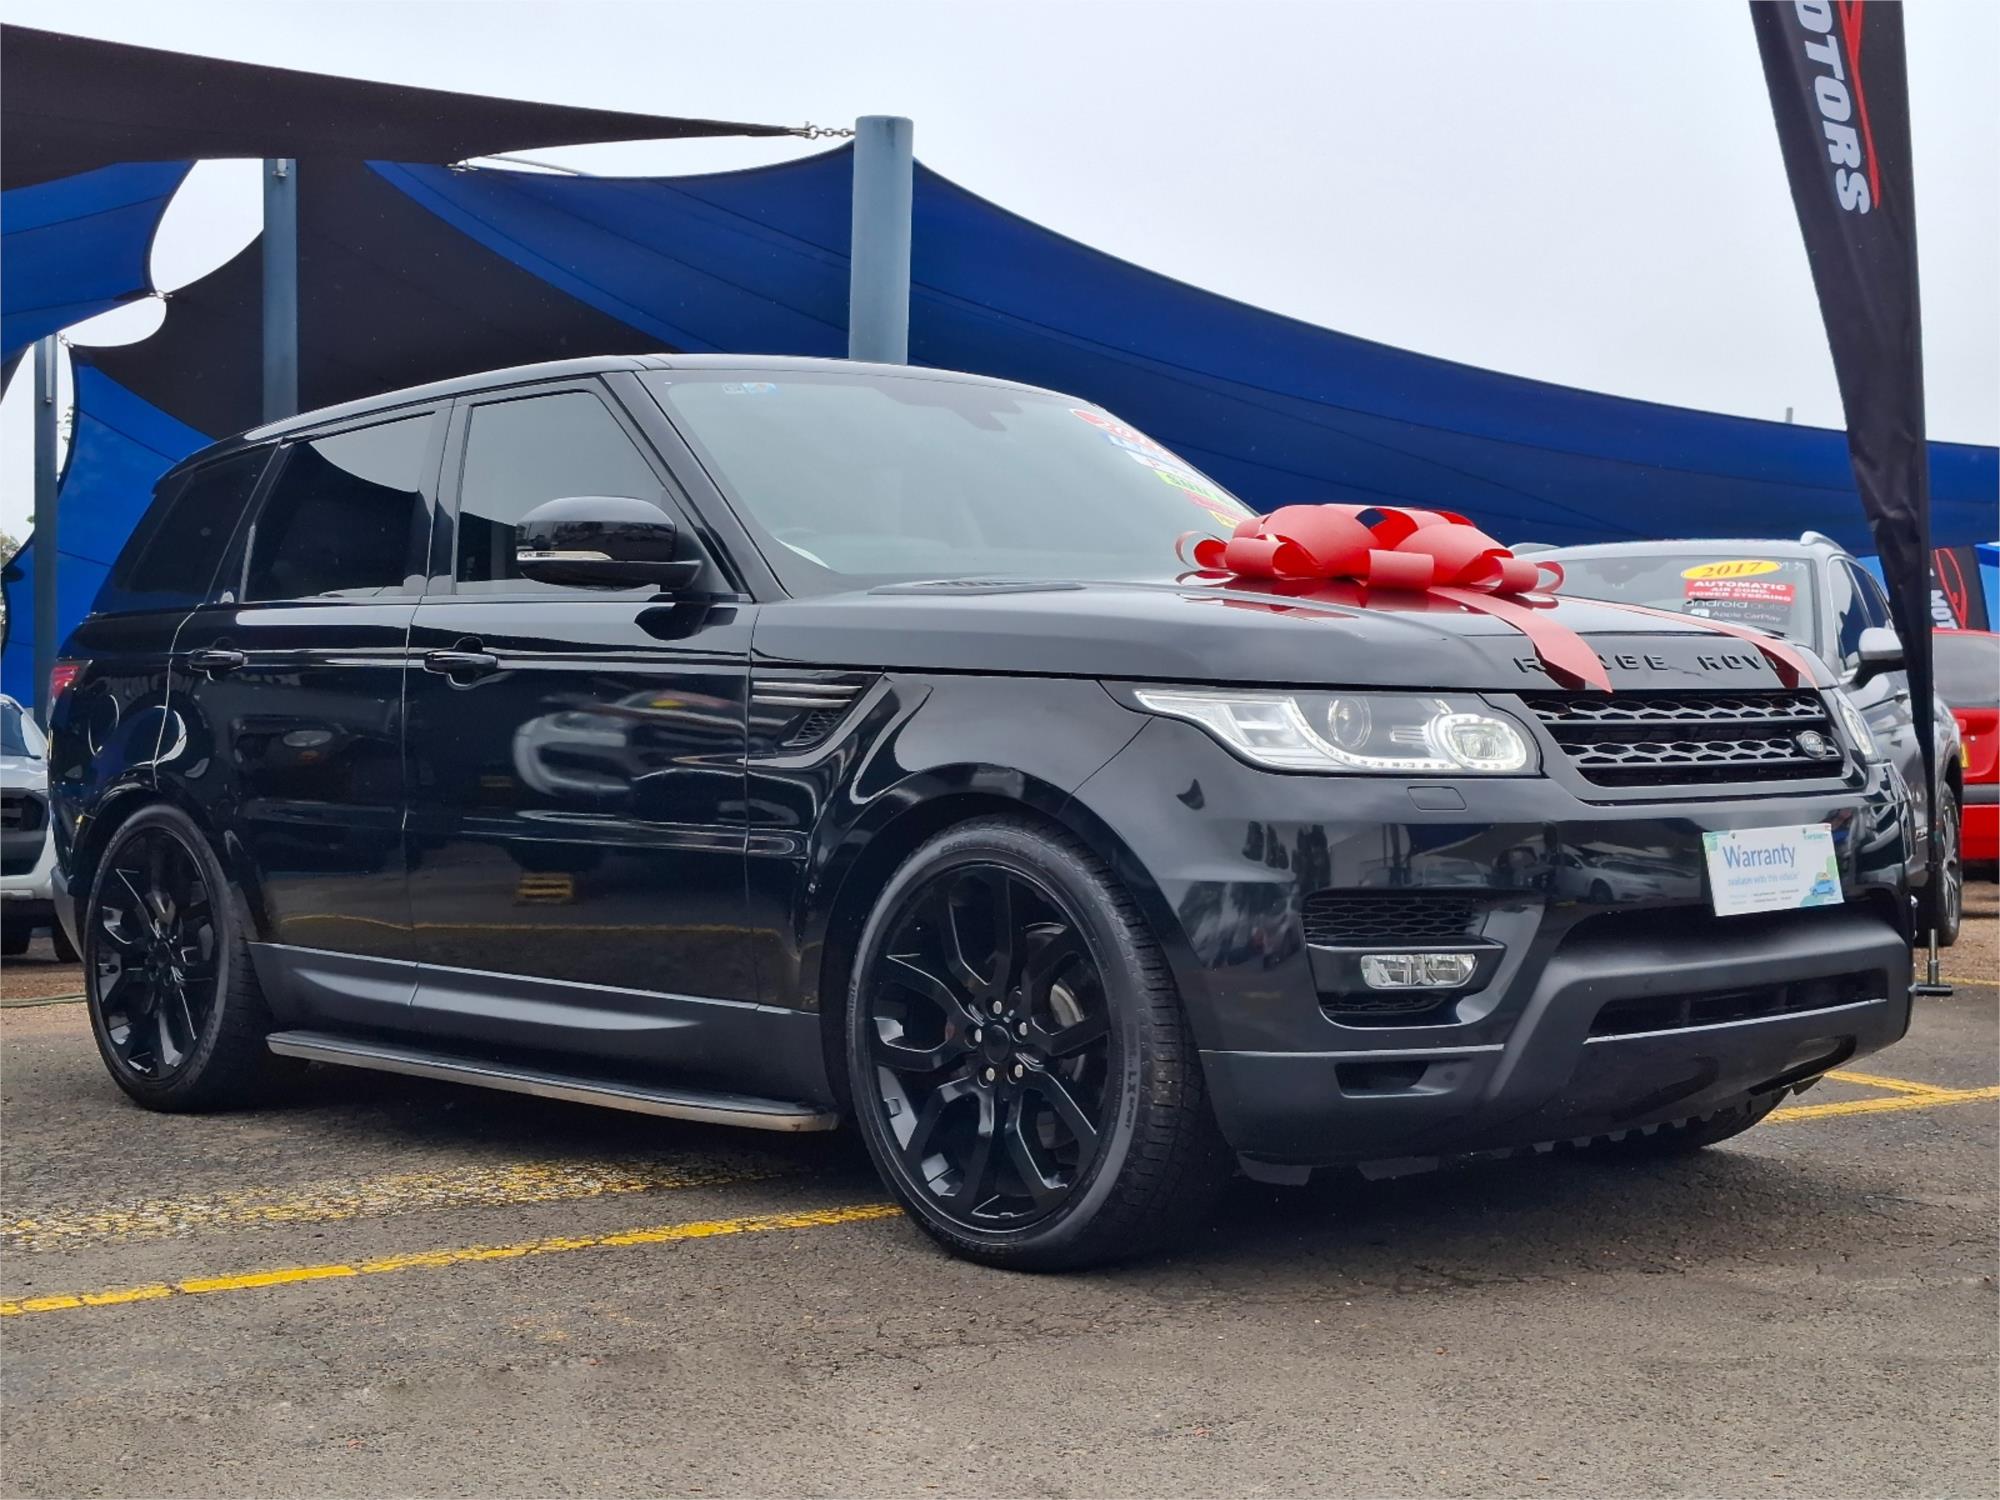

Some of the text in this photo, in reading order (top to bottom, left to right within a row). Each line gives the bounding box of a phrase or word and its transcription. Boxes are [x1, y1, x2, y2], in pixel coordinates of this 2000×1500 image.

[1703, 562, 1761, 577] 2017
[1694, 581, 1787, 591] AUTOMATIC
[1732, 592, 1791, 602] STEERING
[1686, 600, 1748, 608] android
[1712, 611, 1781, 622] Apple CarPlay
[1513, 654, 1668, 673] RGE
[1723, 843, 1795, 868] Warranty
